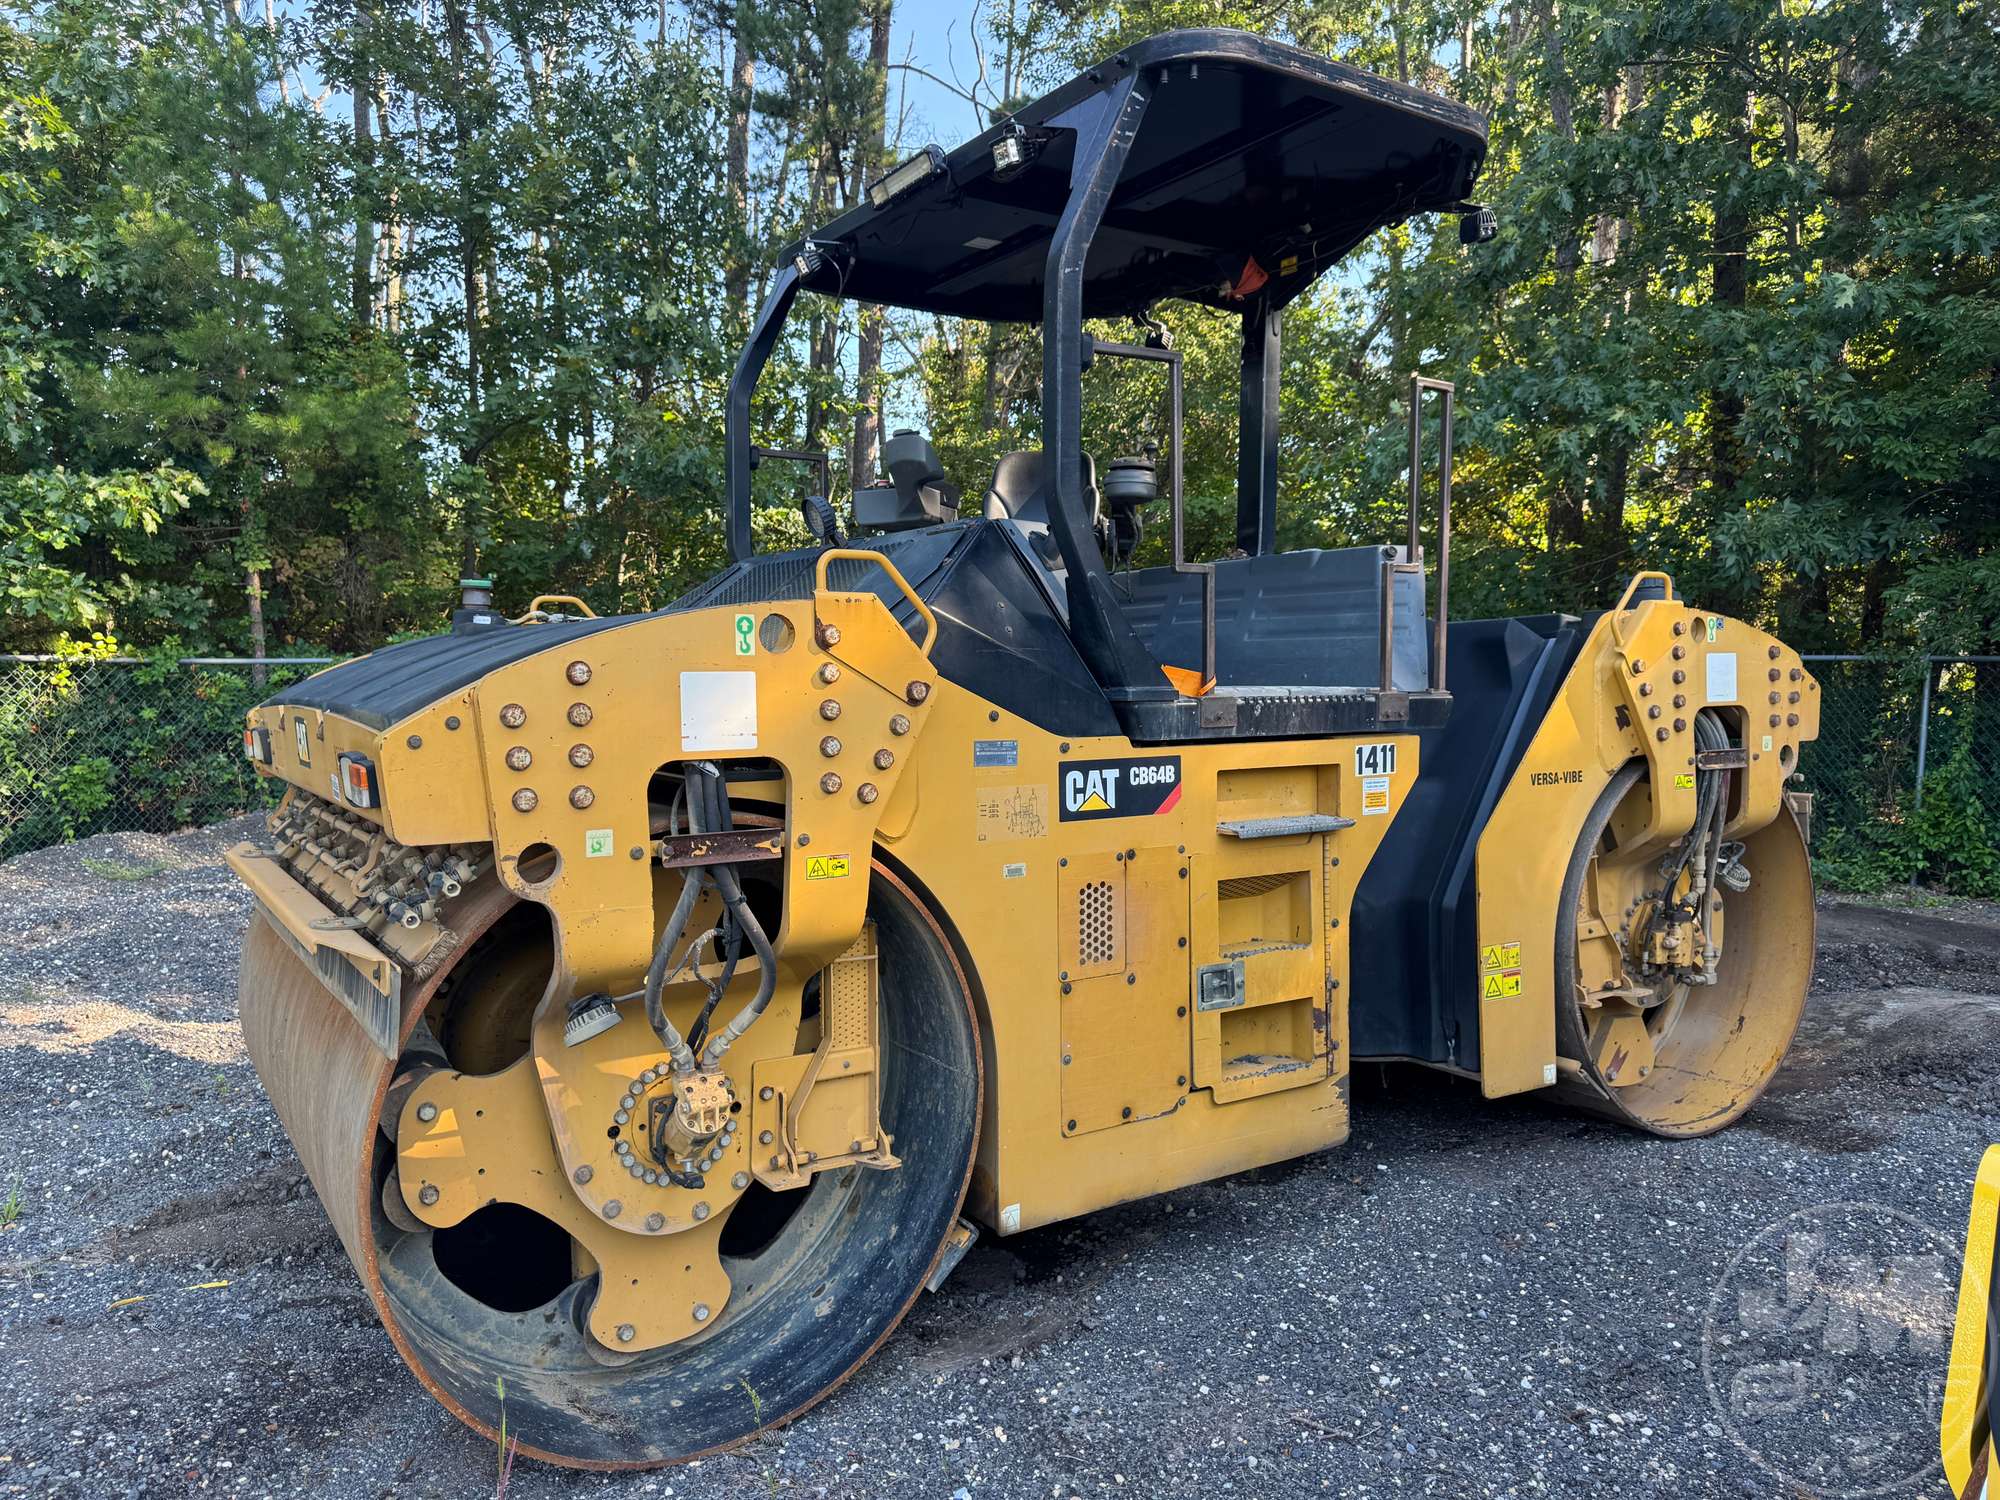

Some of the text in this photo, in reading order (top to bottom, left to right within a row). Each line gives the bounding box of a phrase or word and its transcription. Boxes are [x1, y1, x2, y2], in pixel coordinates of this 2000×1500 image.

[1356, 745, 1395, 775] 1411
[1065, 765, 1175, 811] CAT CB64B
[1531, 770, 1583, 786] VERSA-VIBE
